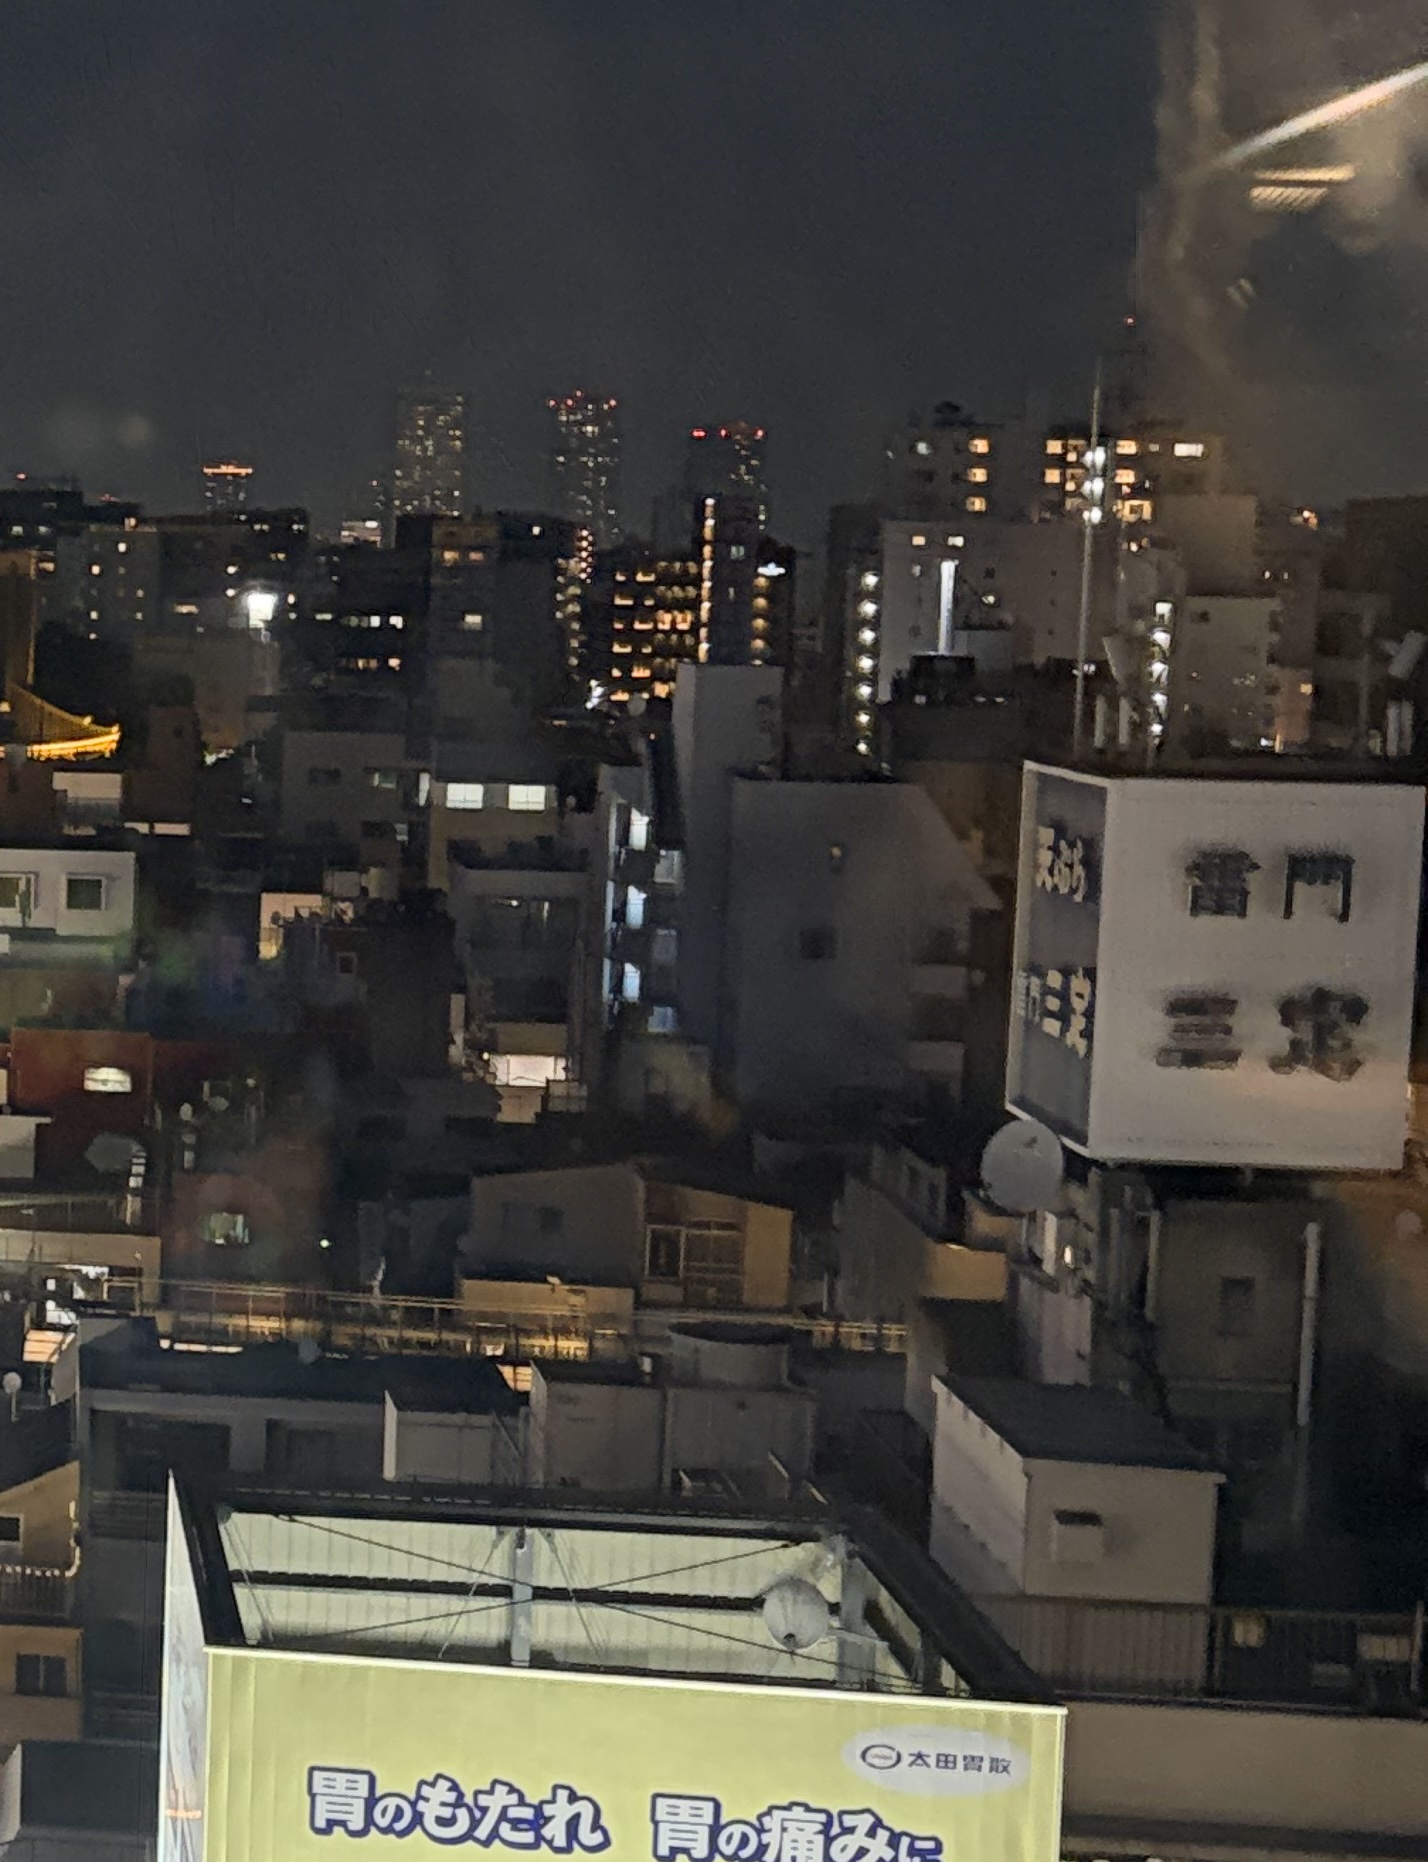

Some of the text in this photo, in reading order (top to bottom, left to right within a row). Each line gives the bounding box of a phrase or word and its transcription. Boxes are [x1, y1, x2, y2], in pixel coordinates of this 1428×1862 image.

[907, 1749, 1013, 1776] 太田胃散
[306, 1765, 610, 1852] 胃のもたれ
